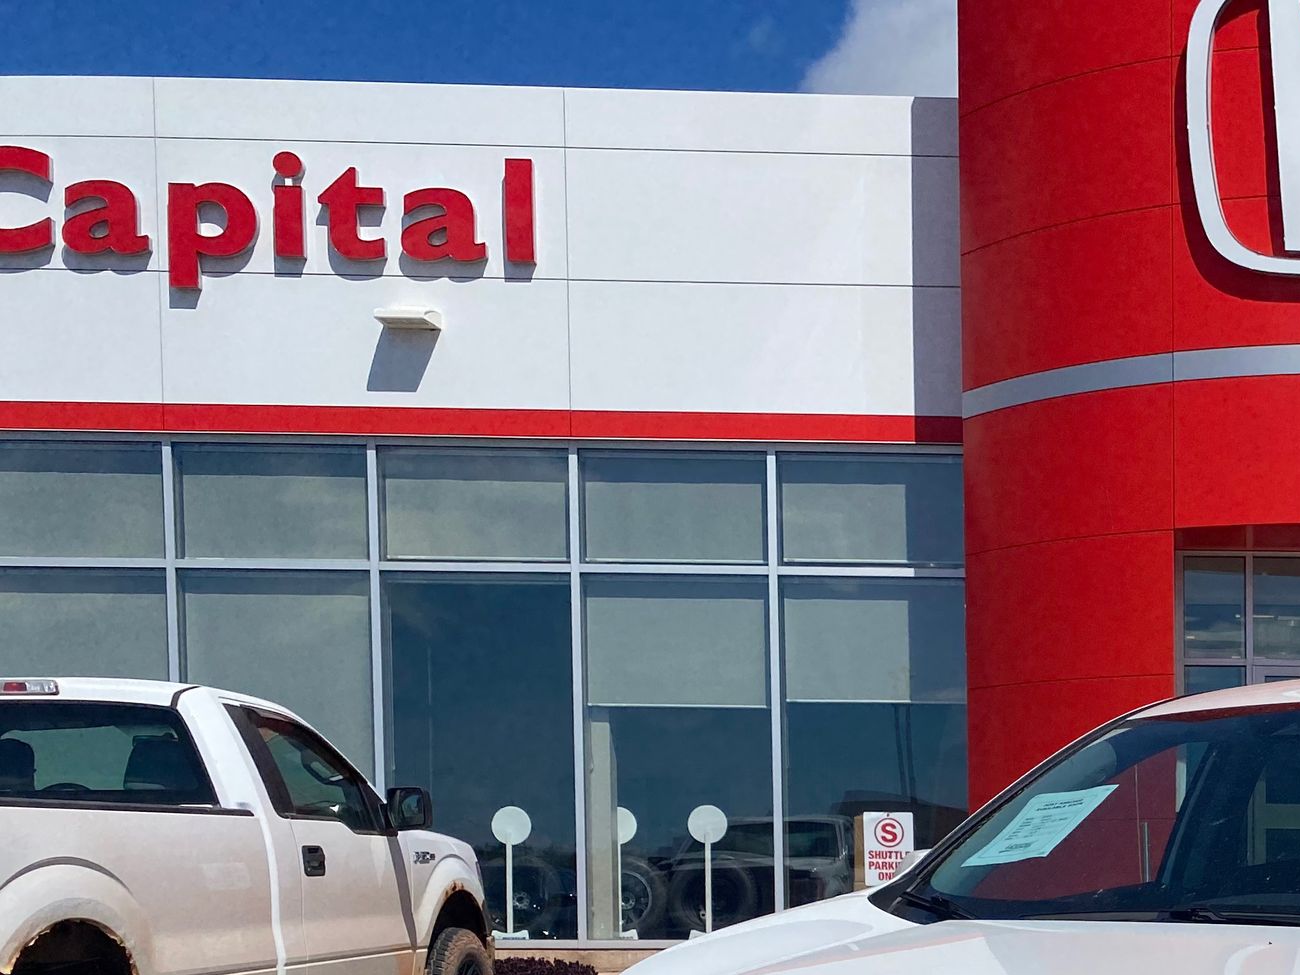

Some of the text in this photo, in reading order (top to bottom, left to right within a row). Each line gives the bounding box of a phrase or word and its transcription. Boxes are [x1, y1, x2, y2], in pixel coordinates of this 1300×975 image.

[881, 823, 897, 842] S
[868, 850, 910, 859] SHUTTL
[868, 861, 901, 869] PARKI
[878, 872, 895, 880] ON
